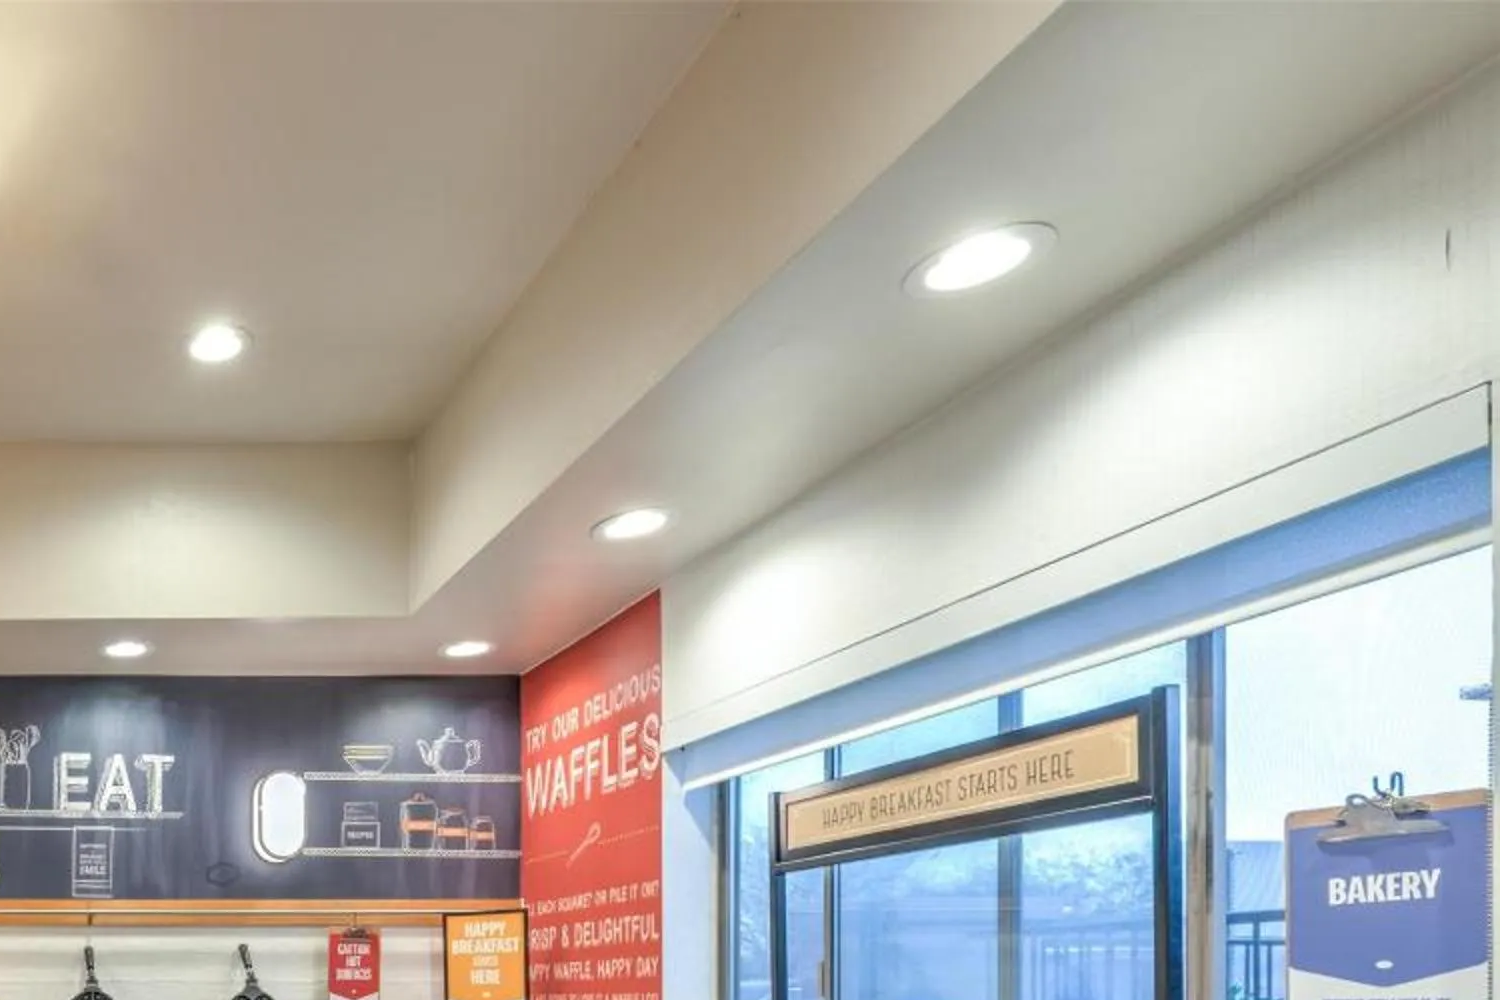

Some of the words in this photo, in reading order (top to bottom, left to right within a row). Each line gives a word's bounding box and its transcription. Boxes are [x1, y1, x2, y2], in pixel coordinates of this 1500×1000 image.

[526, 722, 548, 754] TRY
[552, 707, 580, 742] OUR
[584, 664, 661, 728] DELICIOUS
[53, 752, 175, 818] EAT
[526, 712, 660, 820] WAFFLES
[822, 803, 864, 829] HAPPY
[870, 779, 952, 820] BREAKFAST
[957, 764, 1018, 801] STARTS
[1026, 750, 1076, 787] HERE
[1328, 868, 1441, 906] BAKERY
[451, 936, 520, 955] BREAKFAST
[464, 920, 507, 938] HAPPY
[530, 926, 557, 951] RISP
[574, 912, 660, 948] DELIGHTFUL
[597, 957, 632, 979] HAPPY
[636, 955, 659, 978] DAY
